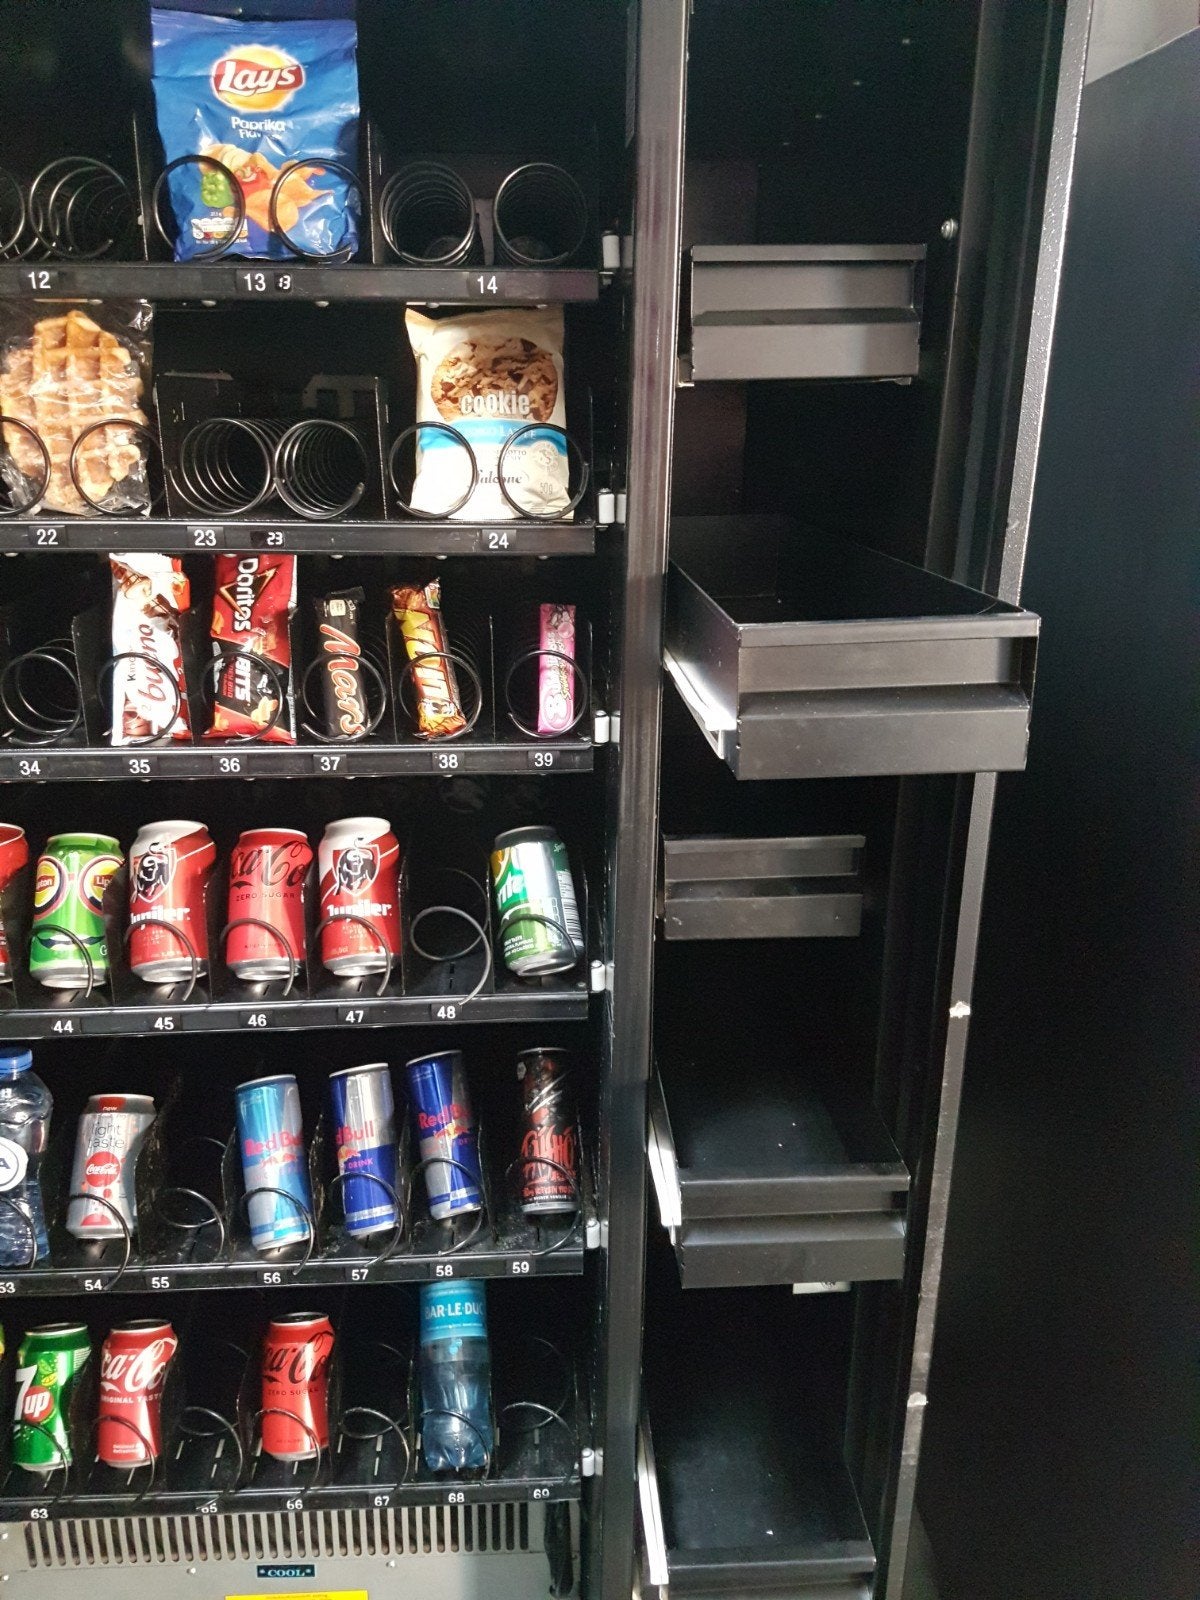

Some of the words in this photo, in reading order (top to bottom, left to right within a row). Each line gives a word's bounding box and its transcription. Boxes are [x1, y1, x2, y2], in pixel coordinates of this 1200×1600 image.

[231, 116, 286, 132] Paprika
[28, 271, 51, 290] 12
[243, 272, 267, 292] 13
[477, 275, 499, 294] 14
[460, 390, 531, 415] cookie
[36, 529, 59, 545] 22
[194, 529, 217, 547] 23
[267, 531, 284, 546] 23
[488, 532, 510, 549] 24
[234, 557, 259, 633] Doritos
[394, 609, 450, 701] LION
[319, 623, 366, 734] Mars
[128, 759, 151, 774] 35
[219, 757, 241, 773] 36
[320, 756, 340, 771] 37
[438, 754, 459, 769] 38
[534, 752, 554, 767] 39
[20, 760, 41, 775] 34
[345, 1010, 364, 1023] 47
[436, 1005, 456, 1019] 48
[53, 1019, 74, 1034] 44
[154, 1016, 174, 1030] 45
[248, 1013, 267, 1027] 46
[351, 1268, 369, 1281] 57
[435, 1264, 454, 1277] 58
[512, 1261, 530, 1274] 59
[84, 1279, 103, 1291] 54
[151, 1276, 170, 1289] 55
[263, 1272, 282, 1285] 56
[374, 1496, 390, 1507] 67
[448, 1493, 465, 1504] 68
[533, 1489, 550, 1499] 69
[286, 1500, 304, 1510] 66
[30, 1508, 49, 1519] 63
[267, 1569, 306, 1577] COOL
